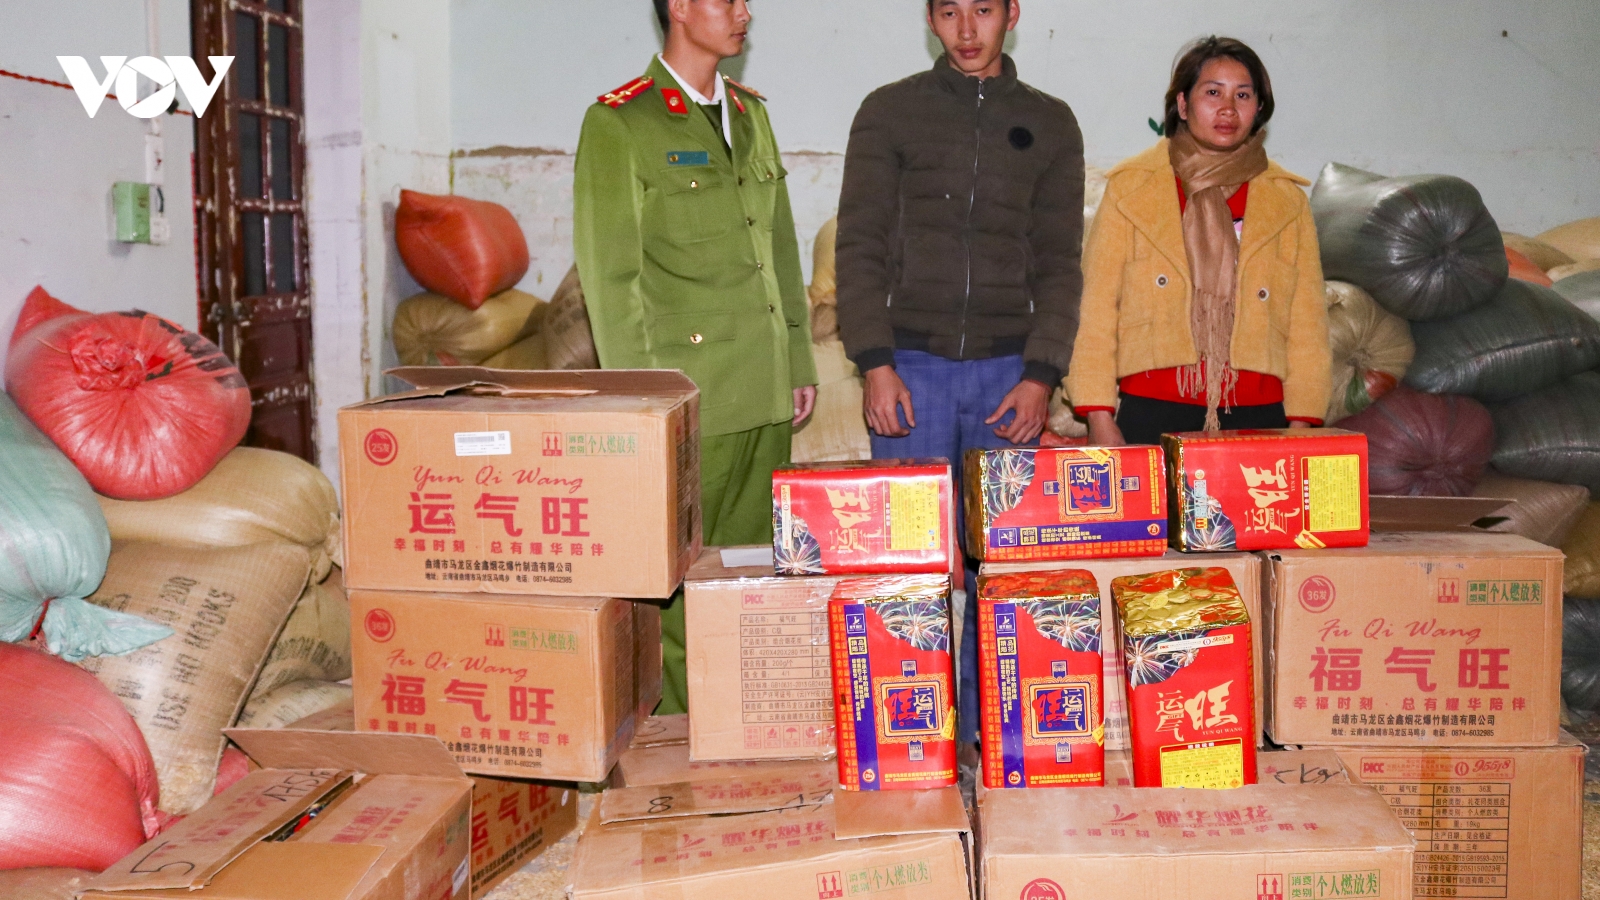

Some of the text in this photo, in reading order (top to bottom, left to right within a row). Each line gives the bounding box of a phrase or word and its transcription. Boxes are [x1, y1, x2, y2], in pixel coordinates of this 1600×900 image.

[413, 465, 584, 493] Yun Qi Wang
[408, 492, 590, 537] 运气旺
[1306, 590, 1326, 600] 36发
[1489, 582, 1540, 602] 个人燃放类
[1318, 618, 1482, 644] Fu Qi Wang
[425, 652, 450, 671] Qi
[460, 656, 528, 683] Wang
[1309, 647, 1510, 692] 福气旺
[381, 673, 556, 726] 福气旺
[1333, 714, 1495, 726] 曲靖市马龙区金鑫烟花爆竹制造有限公司
[1363, 760, 1511, 773] PICC 95518
[1316, 872, 1377, 897] 个人燃放类
